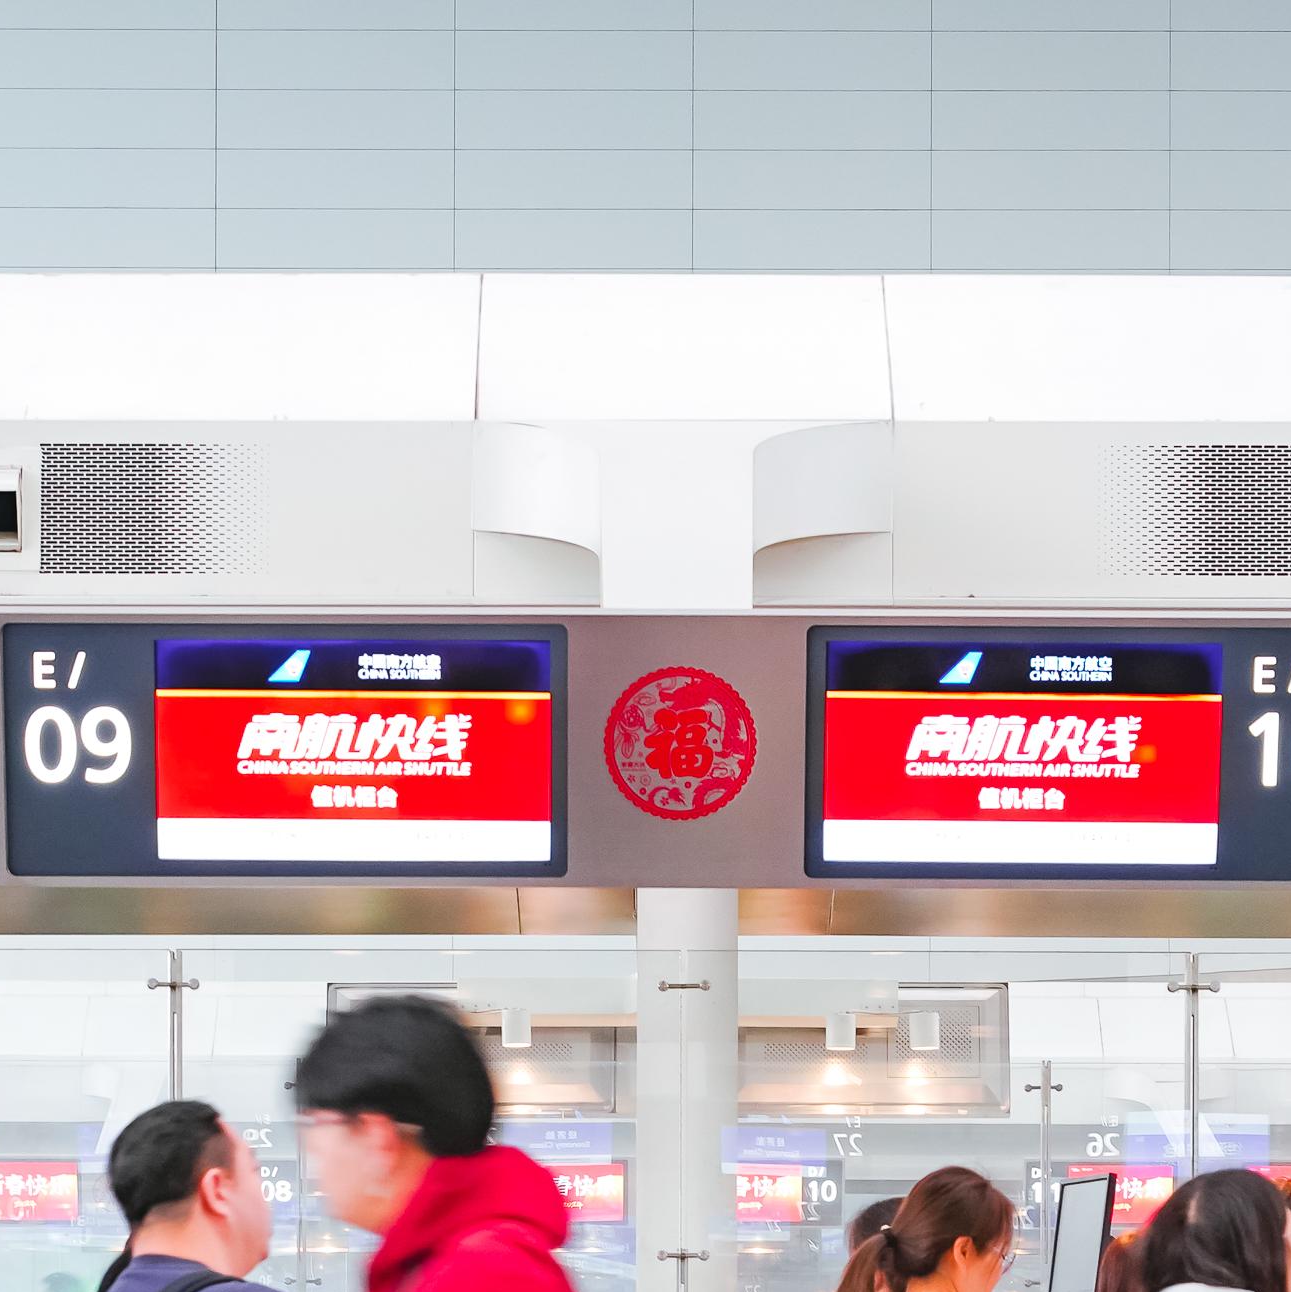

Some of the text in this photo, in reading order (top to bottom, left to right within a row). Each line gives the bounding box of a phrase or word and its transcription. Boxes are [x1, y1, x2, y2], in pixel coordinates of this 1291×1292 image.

[33, 651, 87, 689] E/
[358, 669, 442, 680] CHINA SOUTHERN
[1029, 671, 1112, 682] CHINA SOUTHERN
[24, 705, 132, 784] 09
[237, 713, 473, 760] 南航快线
[644, 708, 714, 780] 福
[905, 714, 1143, 762] 南航快线
[237, 760, 473, 776] CHINA SOUTHERN AIR SHUTTLE
[905, 762, 1141, 778] CHINA SOUTHERN AIR SHUTTLE
[311, 785, 398, 808] 值机柜台
[978, 787, 1065, 810] 值机柜台
[261, 1180, 293, 1202] 08
[808, 1180, 838, 1202] 10
